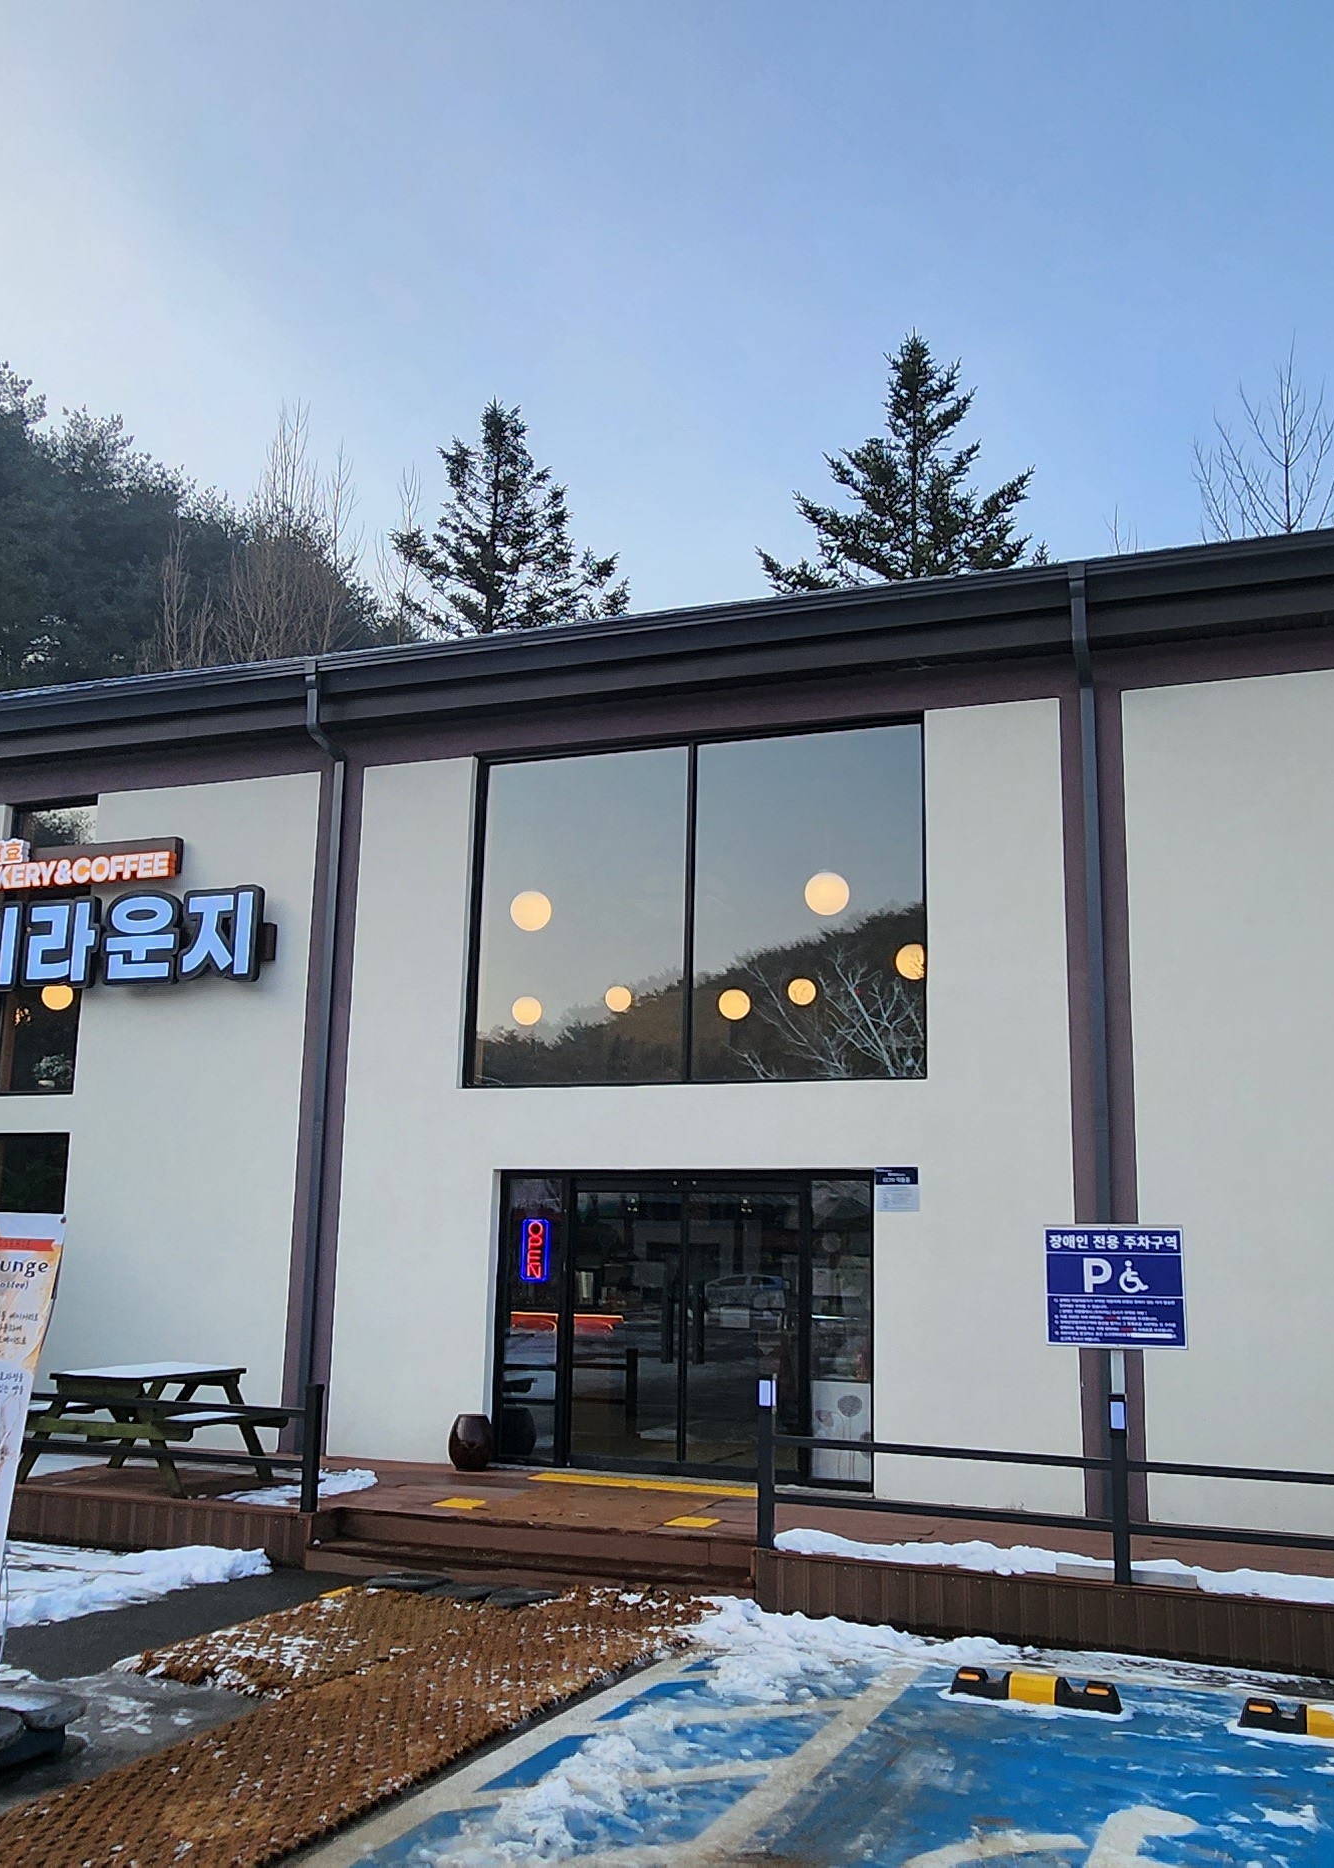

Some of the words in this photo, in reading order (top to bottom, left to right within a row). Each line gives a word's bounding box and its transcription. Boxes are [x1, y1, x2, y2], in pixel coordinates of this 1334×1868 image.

[527, 1221, 543, 1279] OPEN
[1049, 1234, 1089, 1249] 장애인
[1093, 1234, 1120, 1250] 전용
[1123, 1235, 1178, 1250] 주차구역
[1083, 1258, 1113, 1293] P
